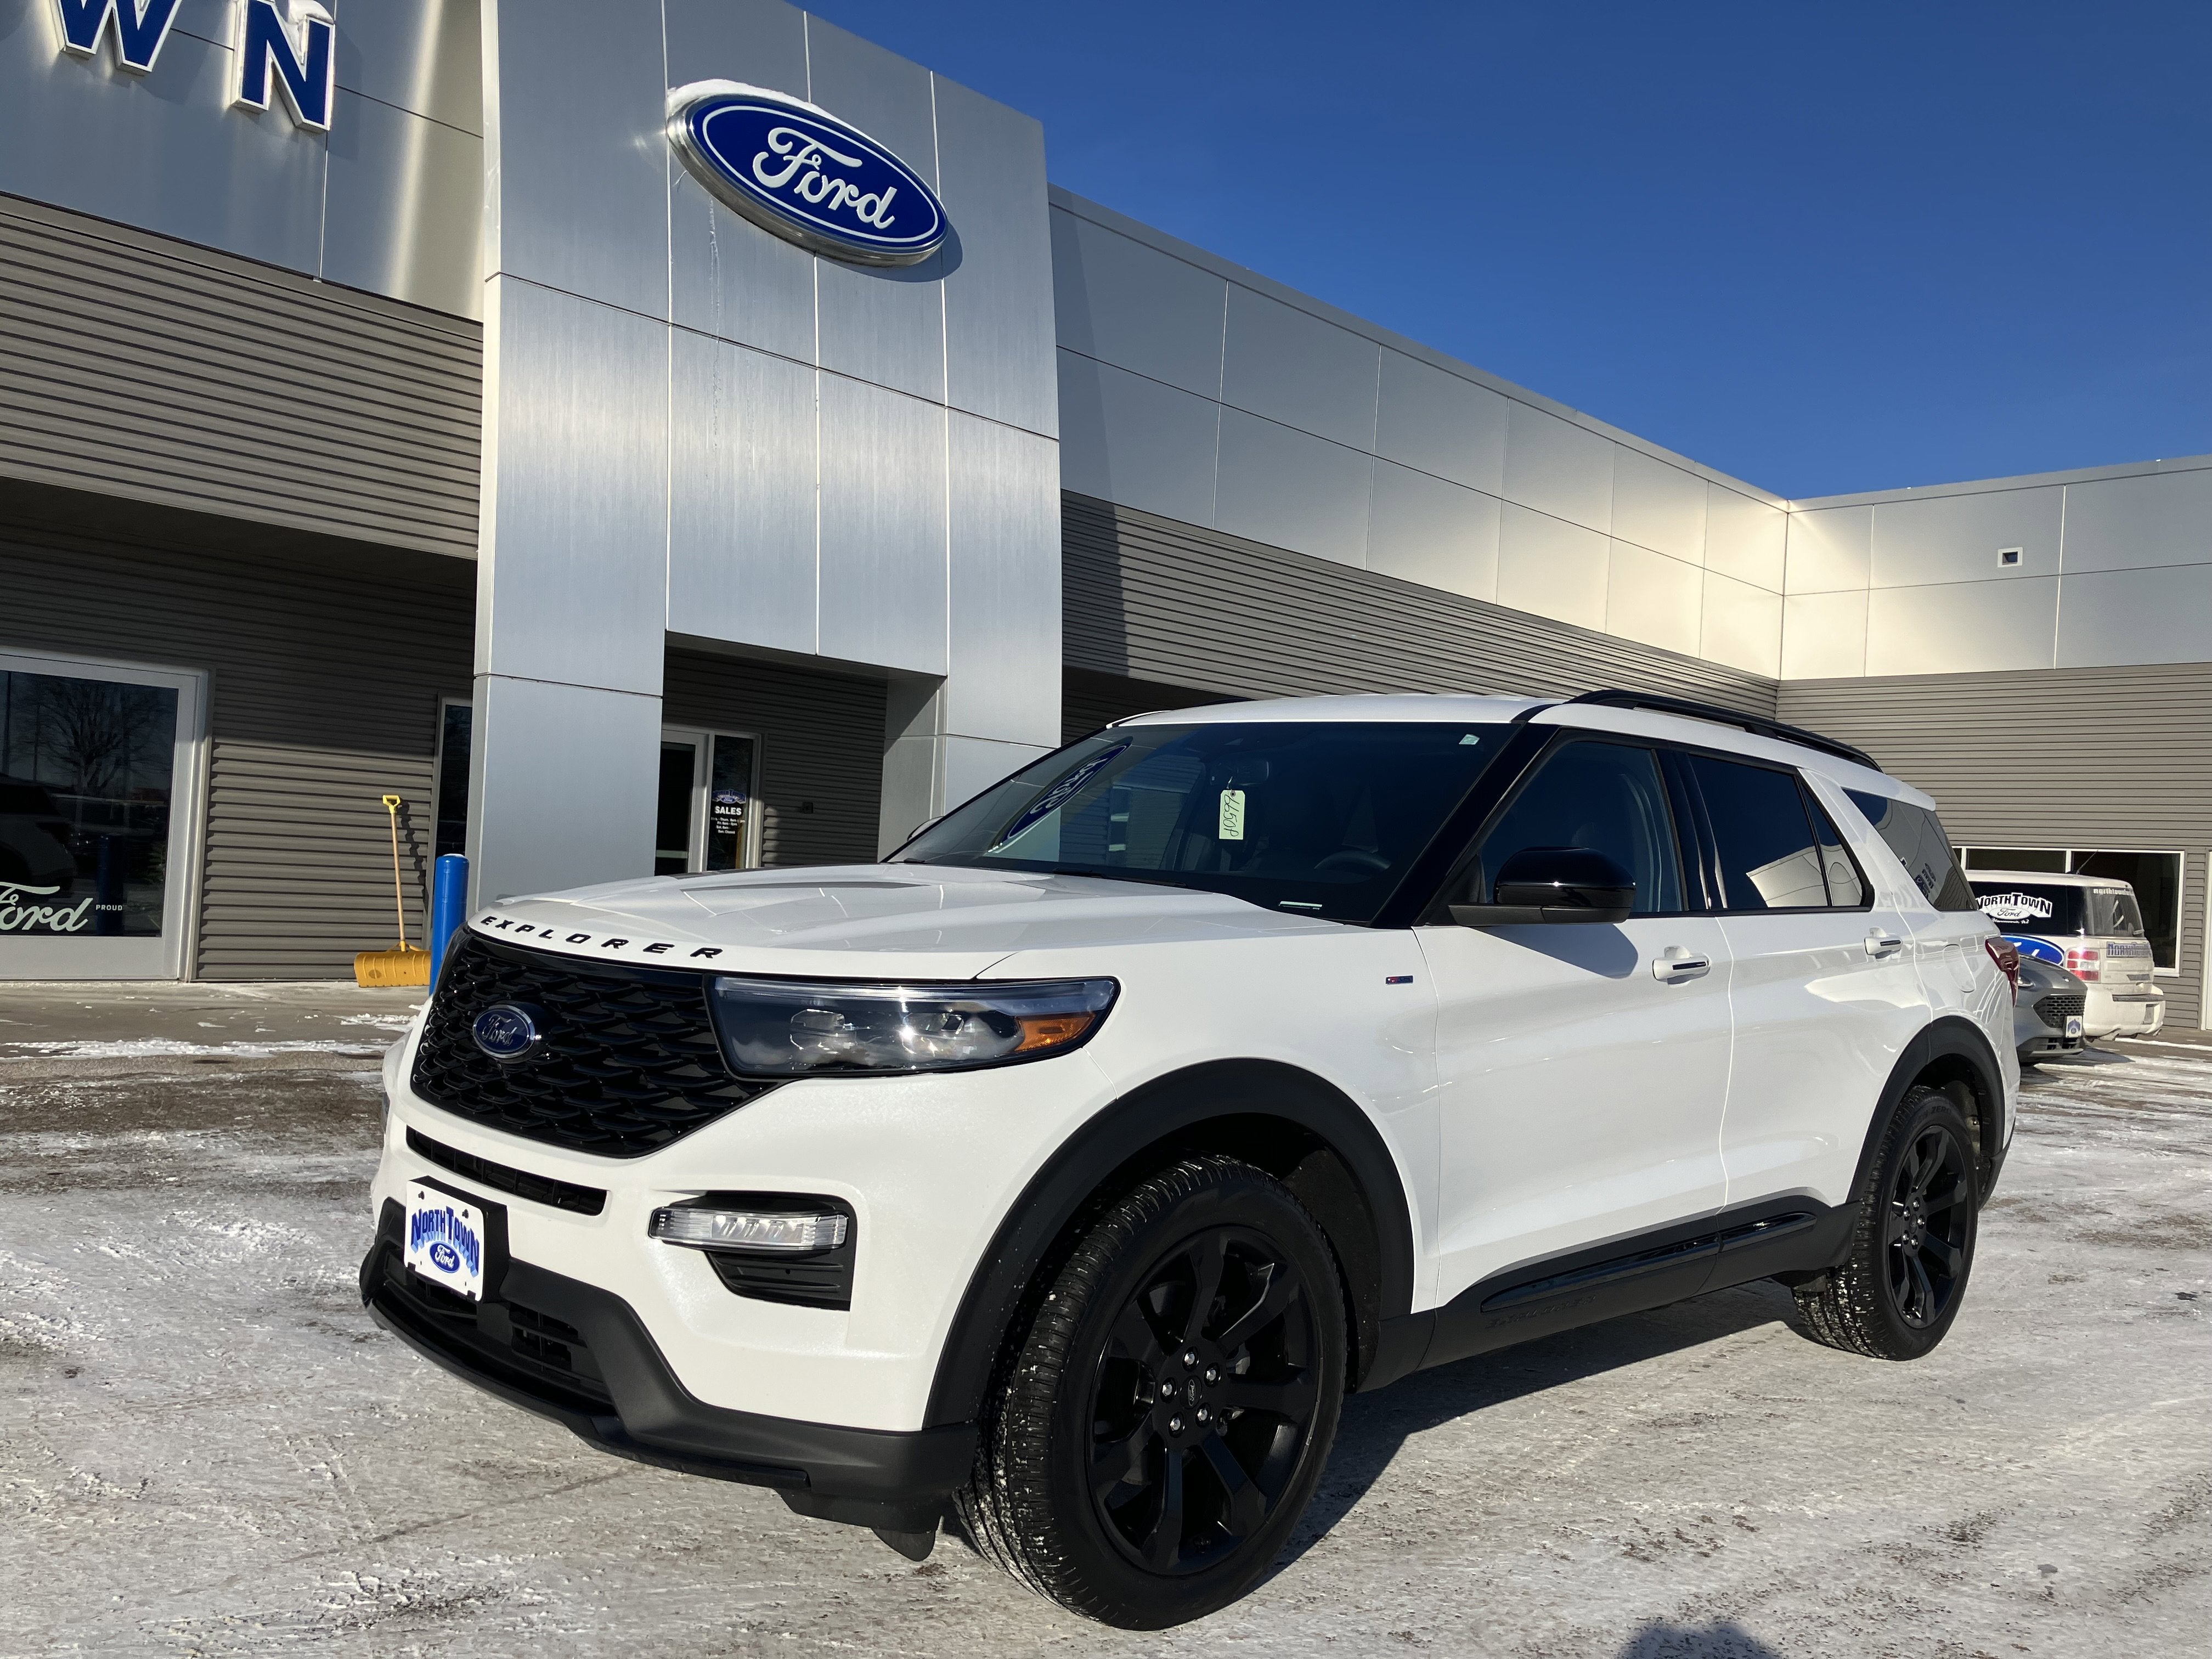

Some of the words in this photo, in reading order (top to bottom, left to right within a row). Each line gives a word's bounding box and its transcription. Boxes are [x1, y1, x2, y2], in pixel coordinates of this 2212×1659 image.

[753, 127, 898, 229] Ford
[715, 805, 742, 816] SALES
[1997, 908, 2022, 917] Ford
[480, 915, 724, 960] EXPLORER
[482, 1014, 517, 1047] Ford
[410, 1205, 479, 1277] NORTHTOWN
[435, 1244, 455, 1268] Ford
